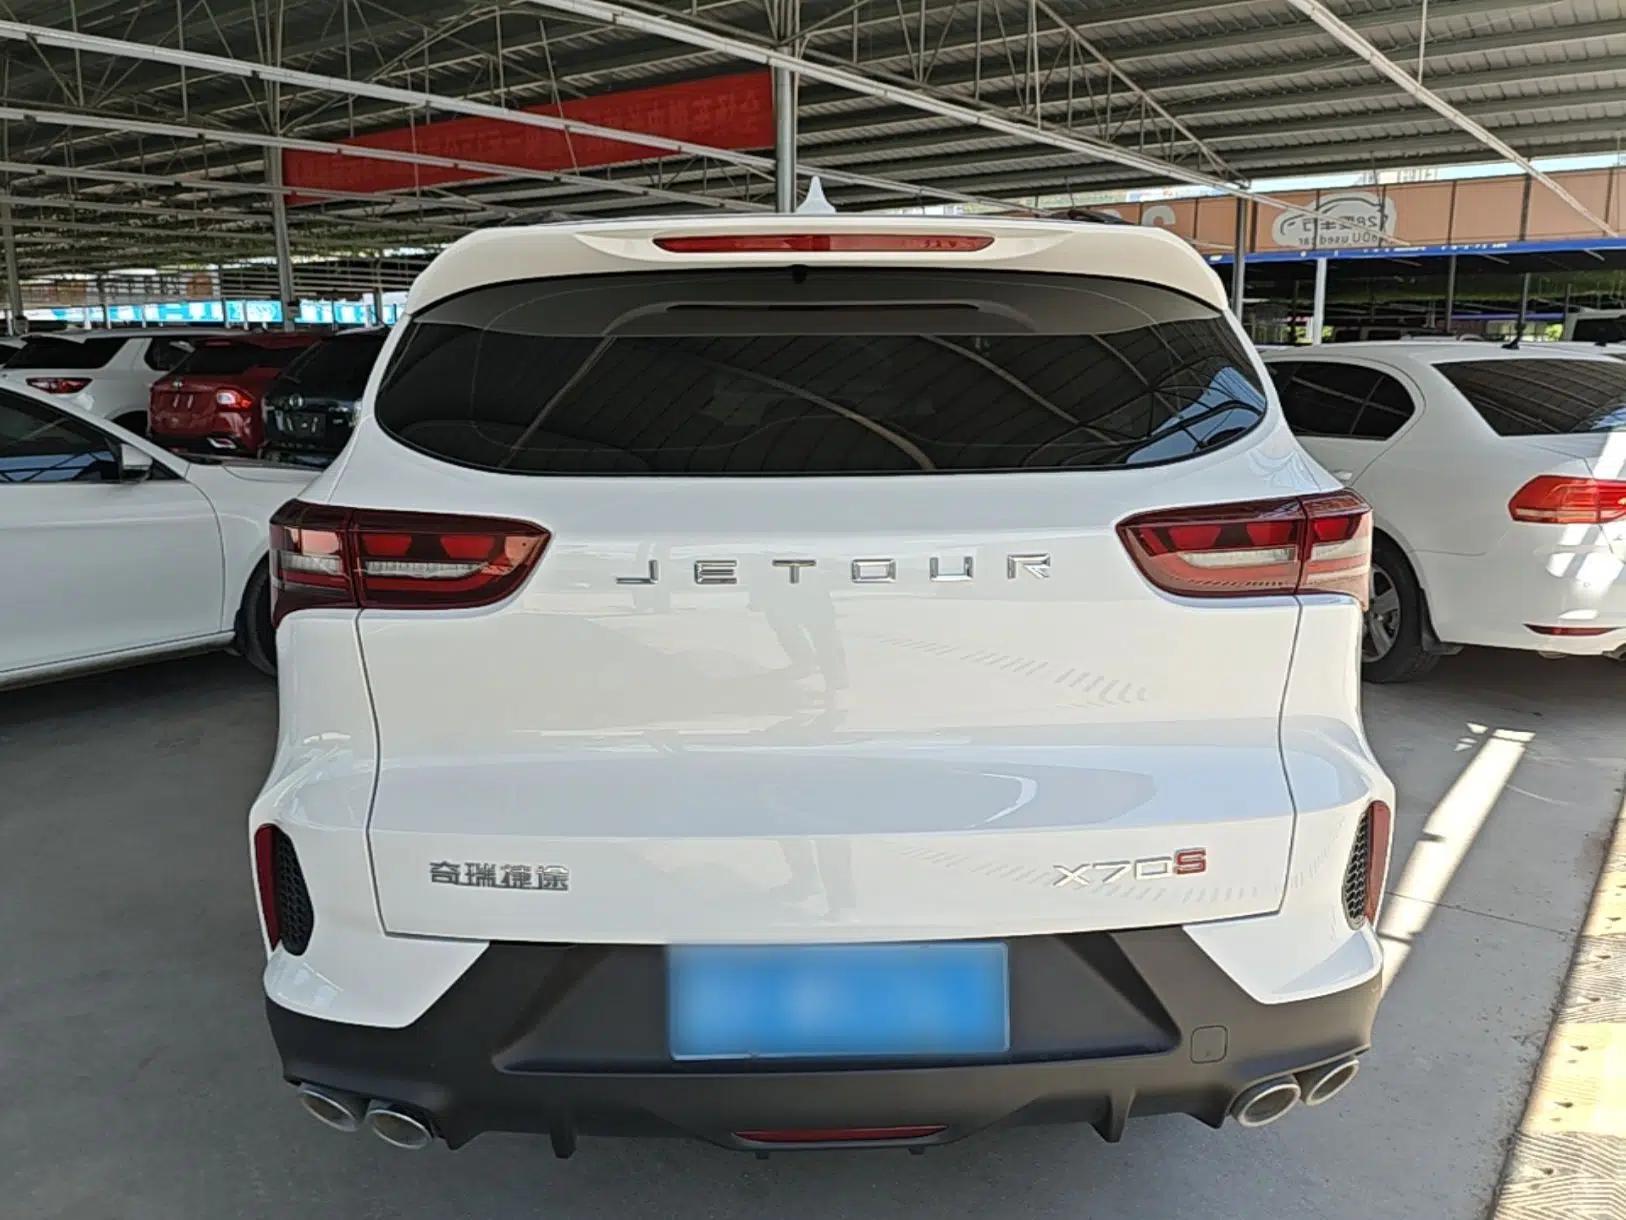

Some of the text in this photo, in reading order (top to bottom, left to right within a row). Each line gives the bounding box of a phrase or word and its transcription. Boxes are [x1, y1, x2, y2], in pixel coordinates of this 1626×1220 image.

[615, 552, 1052, 585] JETOUR
[429, 860, 570, 892] 奇瑞捷途
[1052, 847, 1207, 887] X70S
